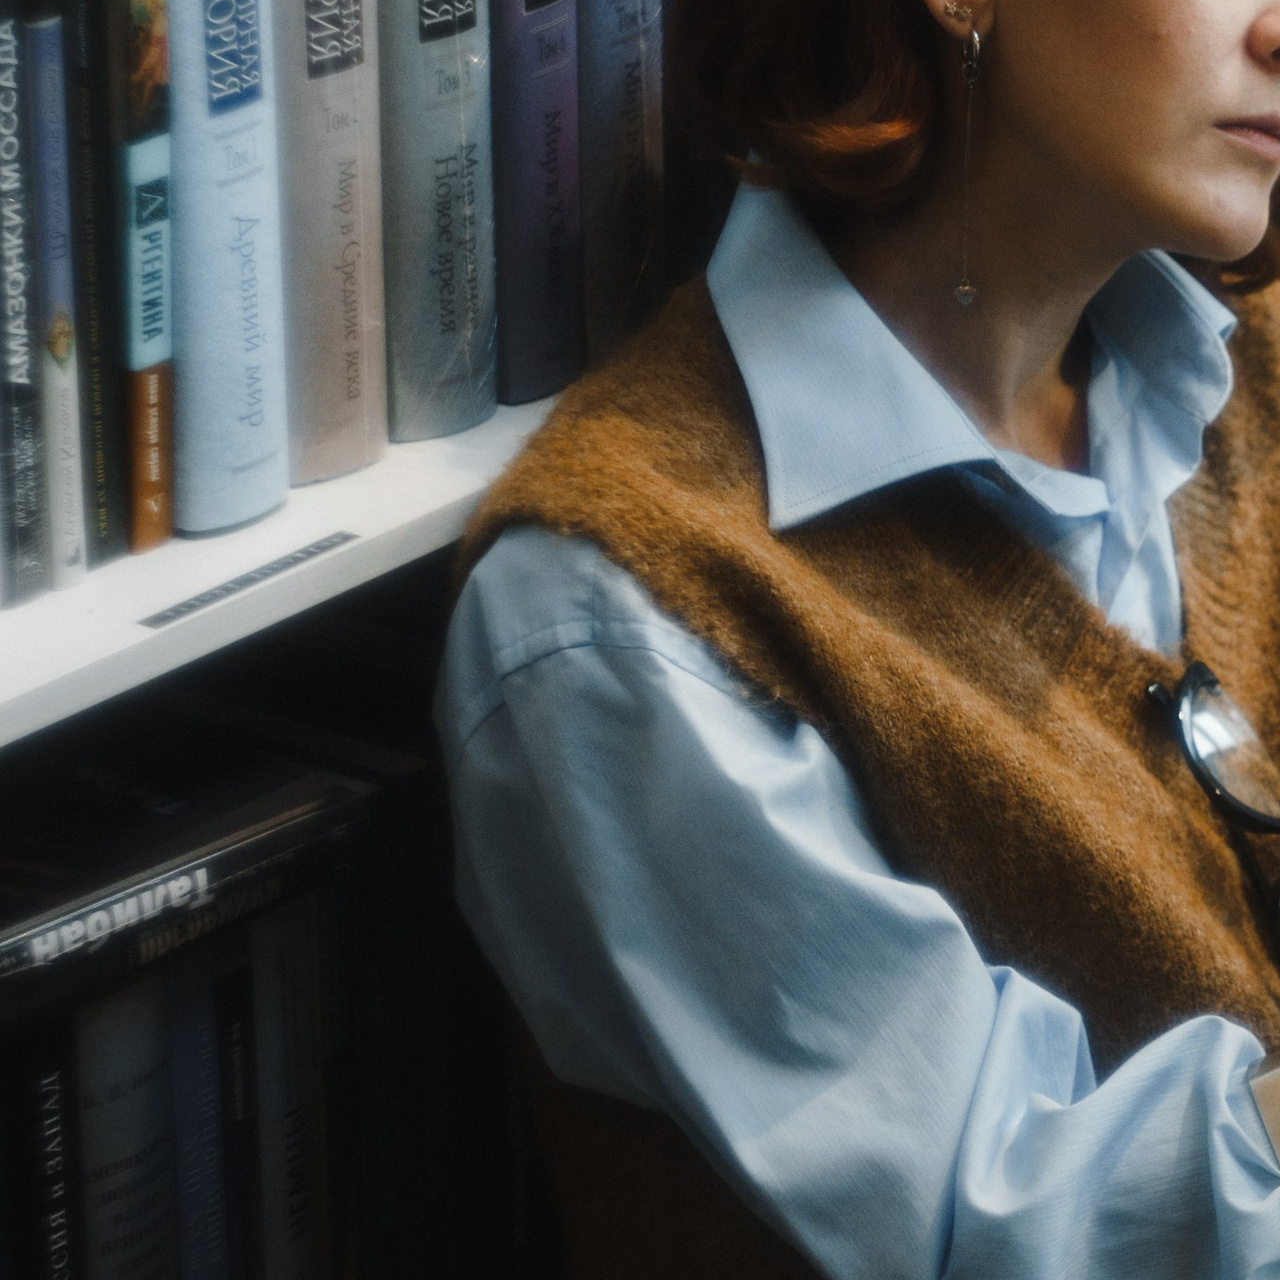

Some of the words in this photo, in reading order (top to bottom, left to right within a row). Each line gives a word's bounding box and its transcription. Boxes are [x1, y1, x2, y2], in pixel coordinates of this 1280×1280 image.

[0, 18, 20, 190] МОССАДА
[332, 159, 357, 215] Мир
[434, 155, 458, 245] Новое
[455, 140, 479, 205] Мир
[340, 222, 354, 237] в
[7, 196, 31, 385] АМАЗОНКИ
[229, 216, 267, 354] Древний
[335, 240, 362, 344] Средние
[429, 251, 457, 335] время
[238, 365, 264, 428] мир
[345, 350, 361, 402] века
[29, 866, 216, 966] Талибан
[38, 1070, 66, 1175] ЗАПАД
[50, 1178, 65, 1197] и
